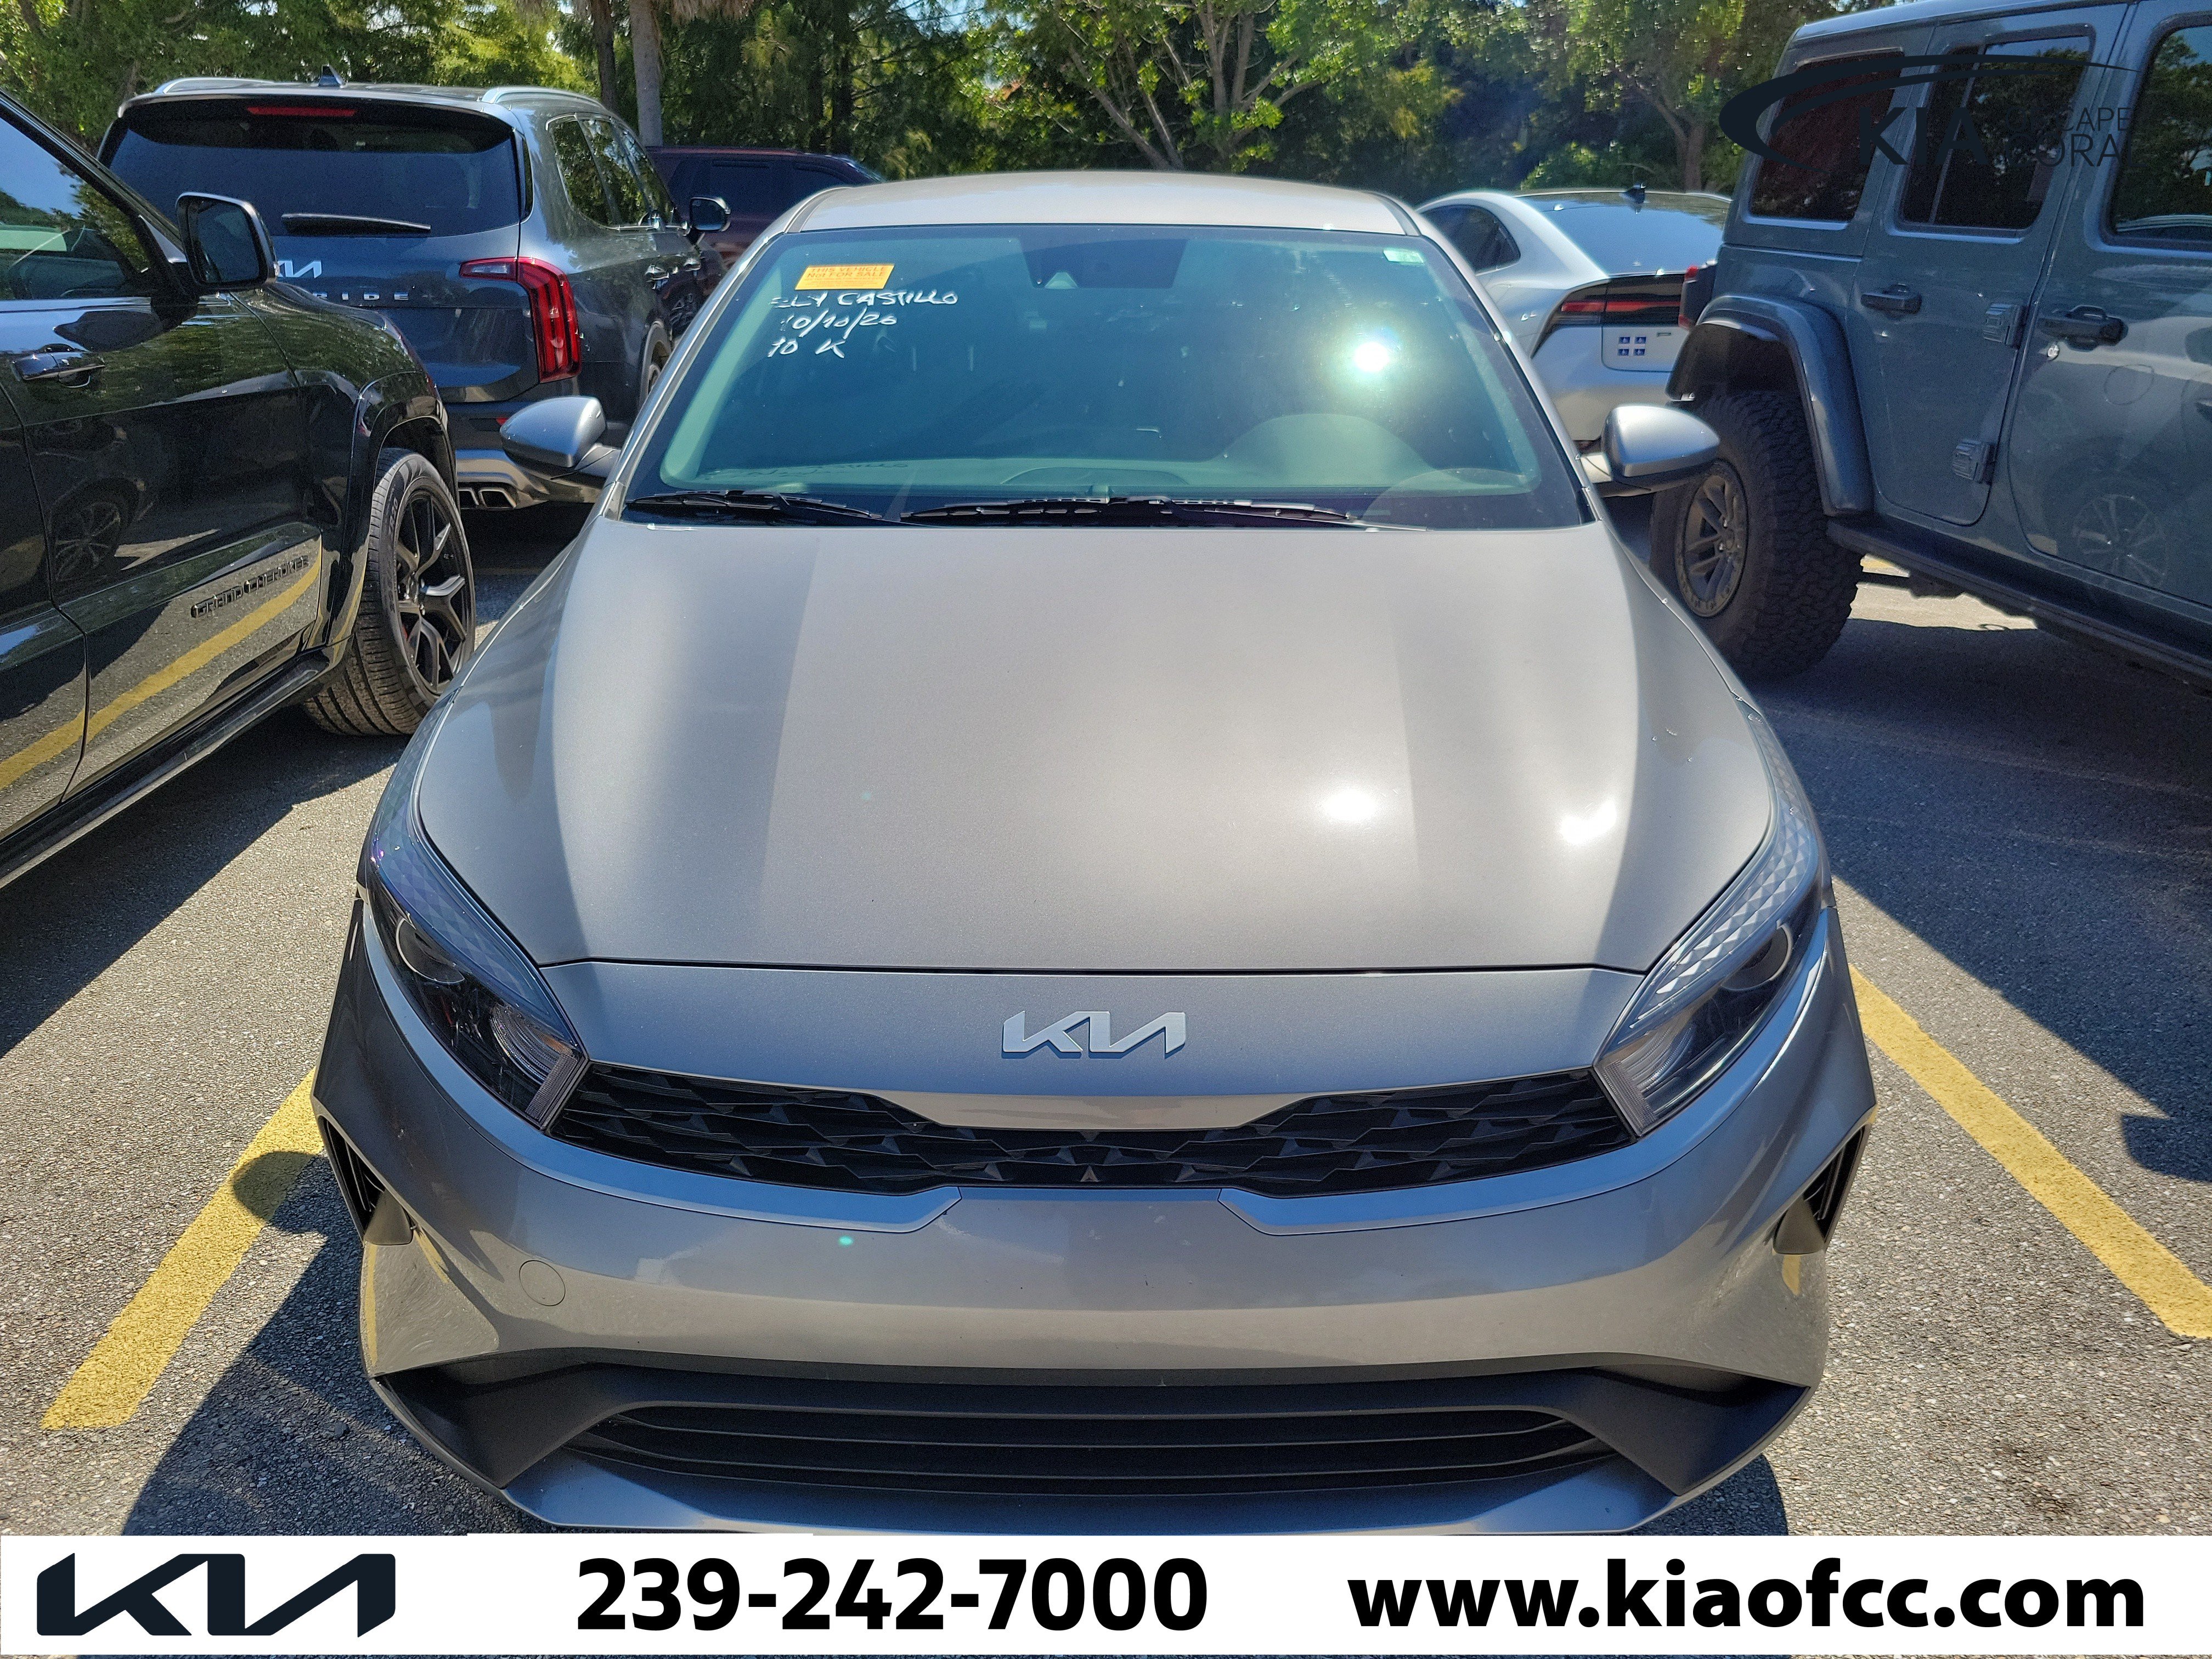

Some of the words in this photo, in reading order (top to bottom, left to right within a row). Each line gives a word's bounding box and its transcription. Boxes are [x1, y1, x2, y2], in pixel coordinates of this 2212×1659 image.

[837, 289, 959, 307] CASTILLO
[815, 338, 847, 358] K
[1002, 1010, 1187, 1059] KIA
